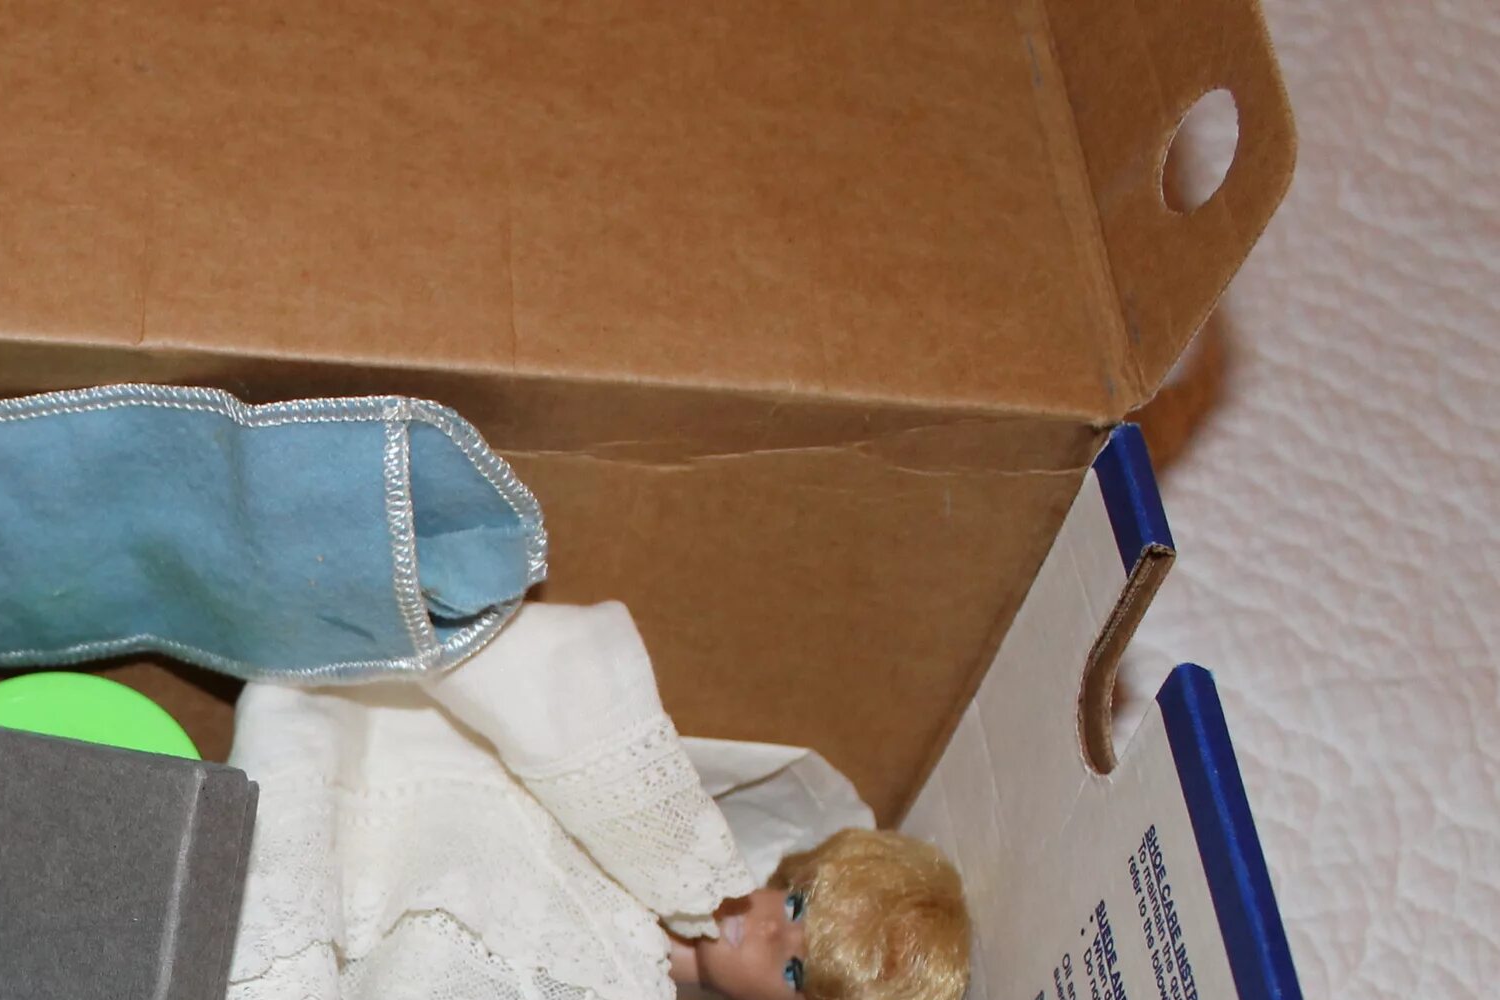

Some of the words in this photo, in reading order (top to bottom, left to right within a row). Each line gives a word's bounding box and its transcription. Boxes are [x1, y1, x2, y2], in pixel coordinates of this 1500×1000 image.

[1127, 850, 1143, 898] refer
[1144, 821, 1166, 887] SHOE
[1159, 880, 1182, 947] CARE
[1136, 837, 1148, 866] To
[1142, 861, 1166, 943] maintain
[1161, 939, 1175, 976] the
[1137, 894, 1148, 919] to
[1095, 897, 1117, 970] SUEDE
[1142, 915, 1156, 952] the
[1061, 949, 1073, 981] Oil
[1083, 946, 1094, 978] Do
[1091, 931, 1109, 990] When
